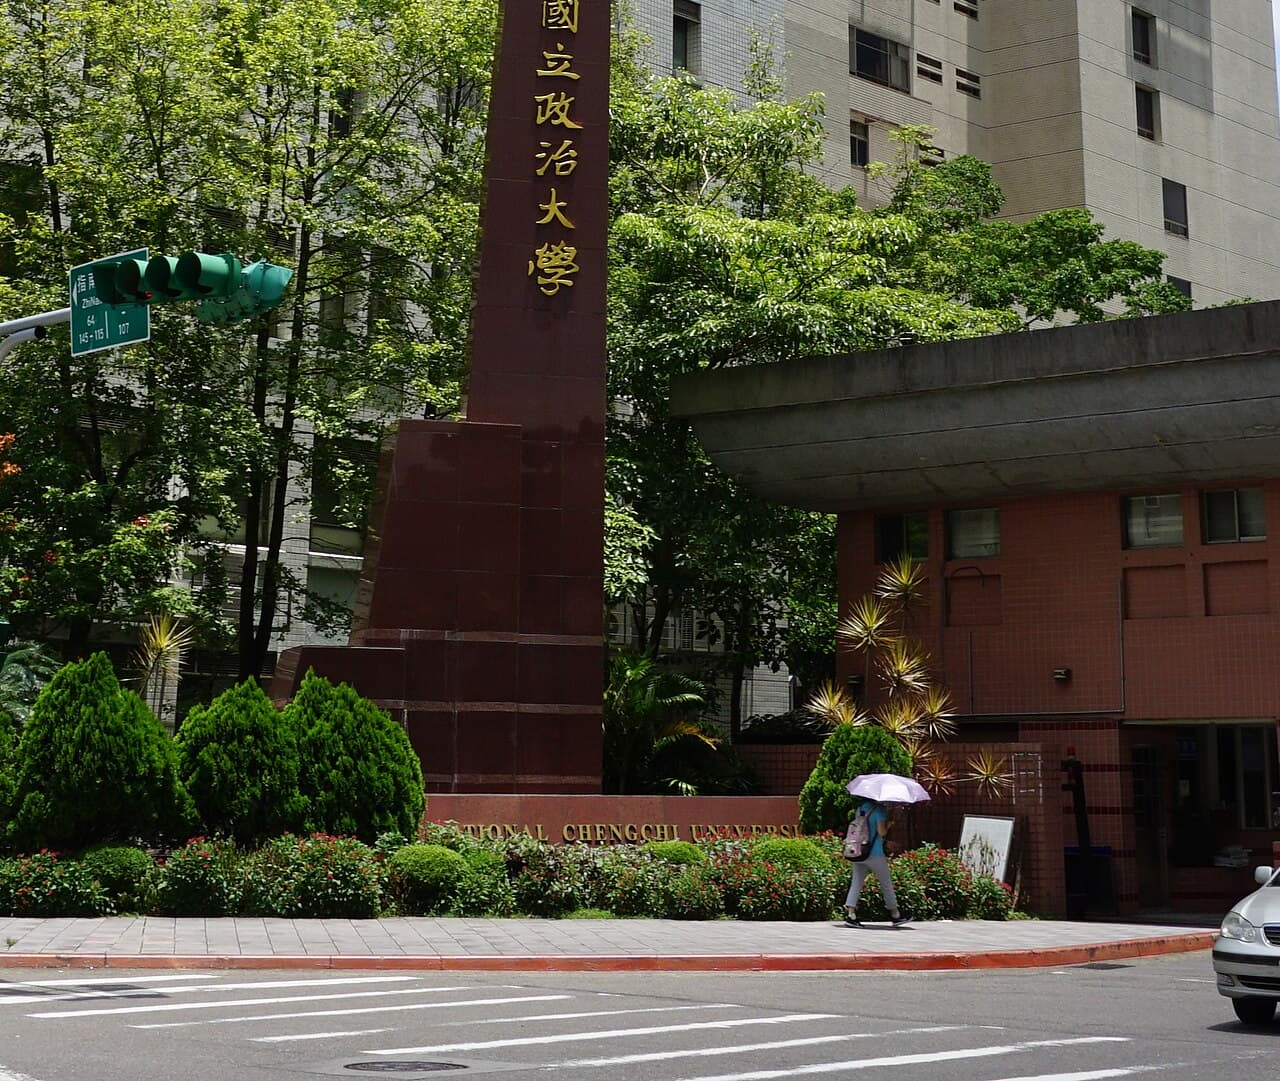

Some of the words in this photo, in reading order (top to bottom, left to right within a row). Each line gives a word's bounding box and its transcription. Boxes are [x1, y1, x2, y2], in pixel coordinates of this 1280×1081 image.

[119, 322, 129, 335] 107
[453, 823, 549, 841] ATIONAL
[562, 823, 678, 841] CHENGCHI
[689, 824, 801, 843] UNIVERSI
